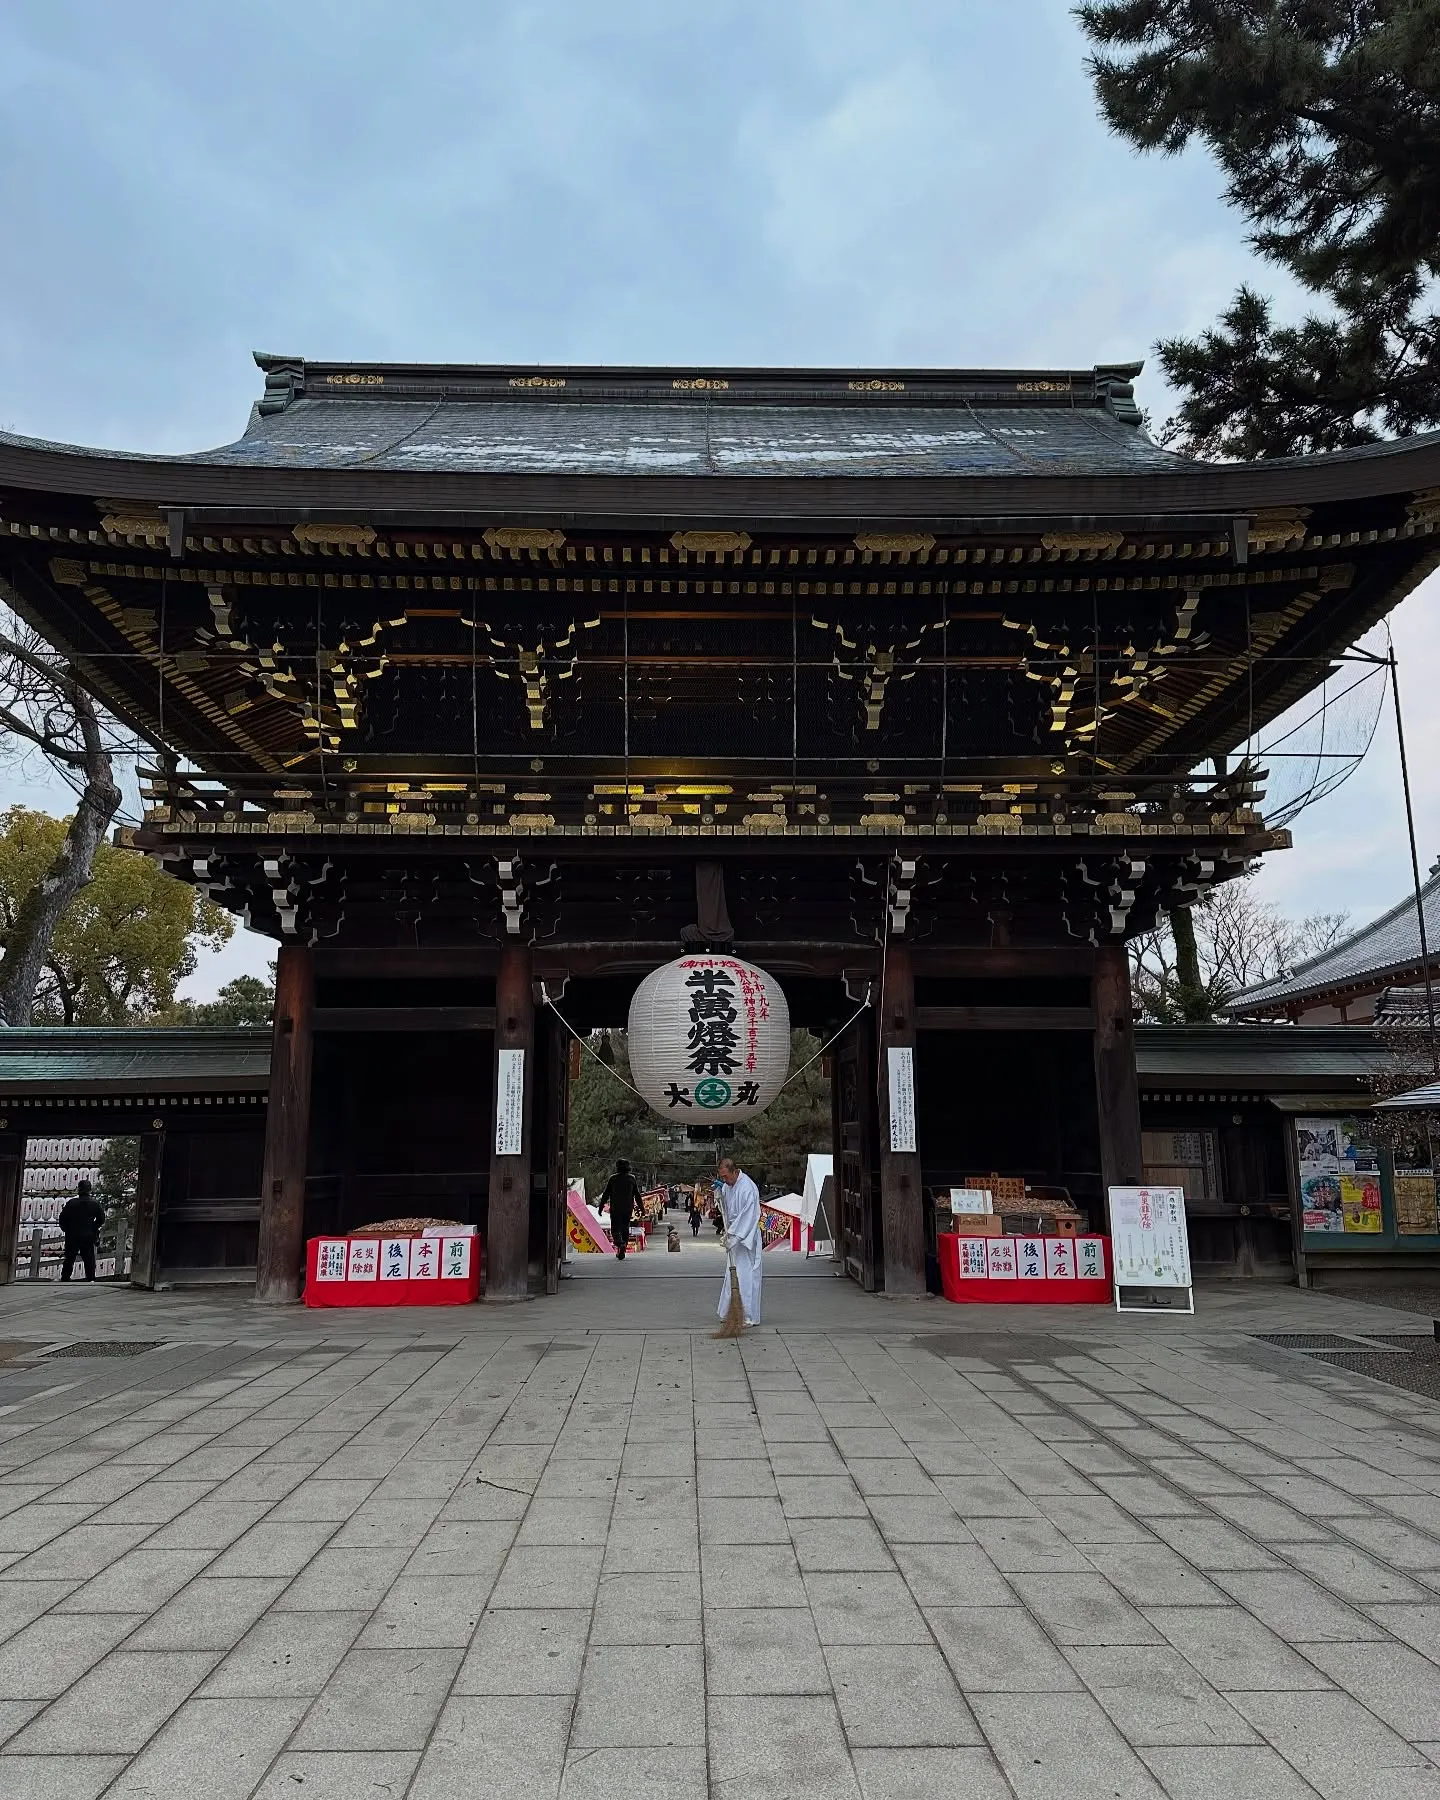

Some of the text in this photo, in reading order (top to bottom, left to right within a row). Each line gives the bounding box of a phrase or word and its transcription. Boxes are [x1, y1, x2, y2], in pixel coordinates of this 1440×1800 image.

[750, 970, 770, 1022] 令和九年
[684, 969, 743, 1076] 半萬燈祭
[663, 1082, 693, 1107] 大
[731, 1080, 761, 1106] 丸
[352, 1247, 363, 1274] 厄除
[362, 1247, 375, 1274] 災難
[386, 1242, 404, 1278] 後厄
[416, 1242, 433, 1277] 本厄
[447, 1241, 465, 1276] 前厄
[990, 1246, 1002, 1272] 厄除
[1002, 1246, 1013, 1272] 災難
[1023, 1242, 1039, 1277] 後厄
[1053, 1242, 1069, 1277] 本厄
[1083, 1242, 1099, 1277] 前厄
